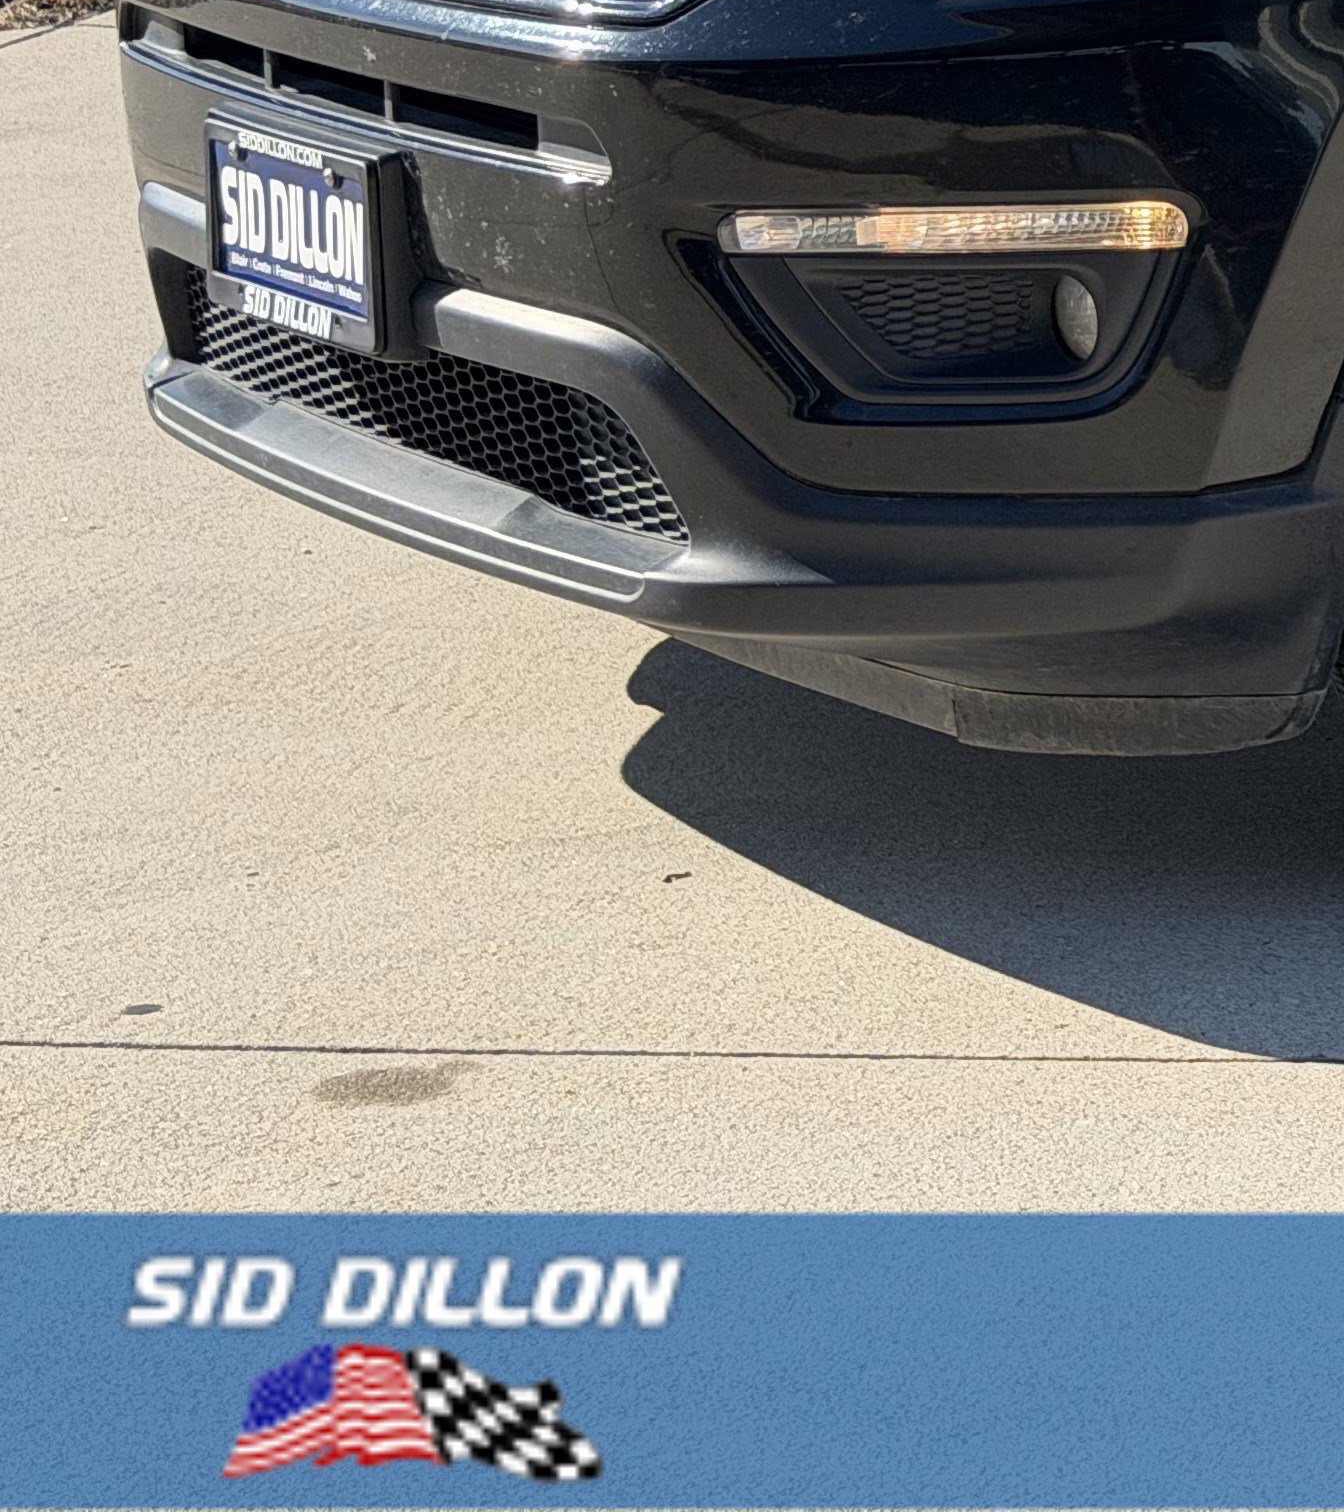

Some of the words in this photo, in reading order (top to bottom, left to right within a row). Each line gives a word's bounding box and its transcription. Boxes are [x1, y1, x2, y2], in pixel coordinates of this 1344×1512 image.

[221, 165, 266, 254] SID
[269, 178, 364, 285] DILLON
[243, 285, 270, 320] SID
[273, 293, 332, 339] DILLON
